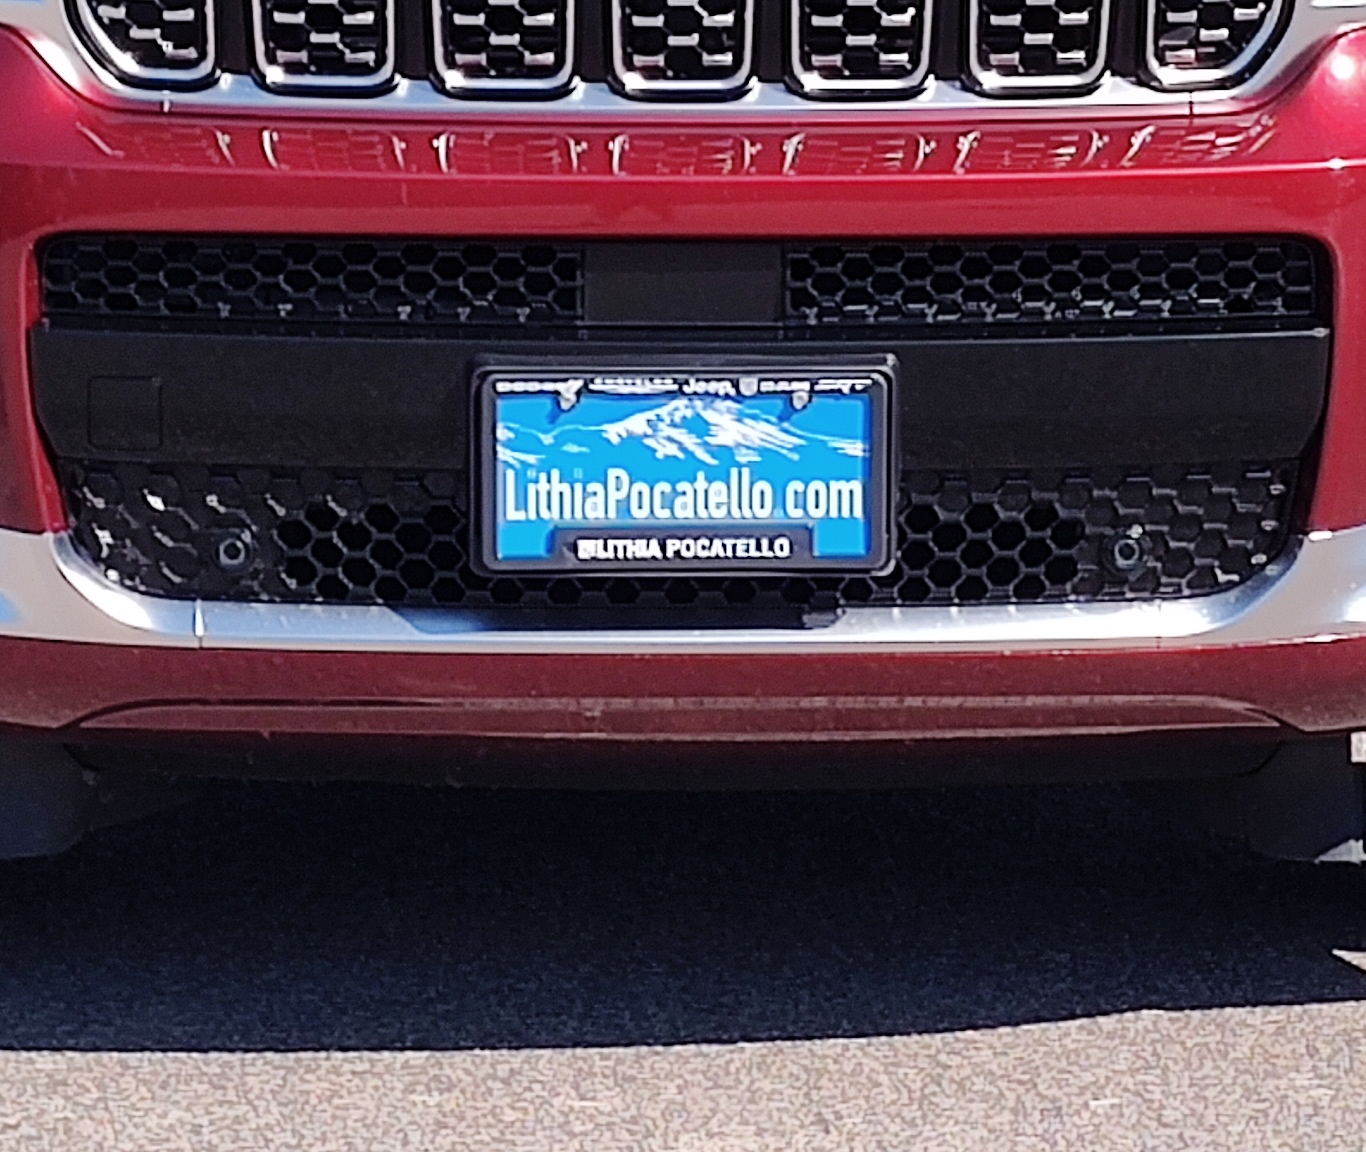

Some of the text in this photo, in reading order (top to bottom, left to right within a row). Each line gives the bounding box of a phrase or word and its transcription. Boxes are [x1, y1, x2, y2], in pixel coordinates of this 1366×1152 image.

[505, 467, 863, 521] LithiaPocatello.com
[596, 537, 791, 560] LITHIA POCATELLO
